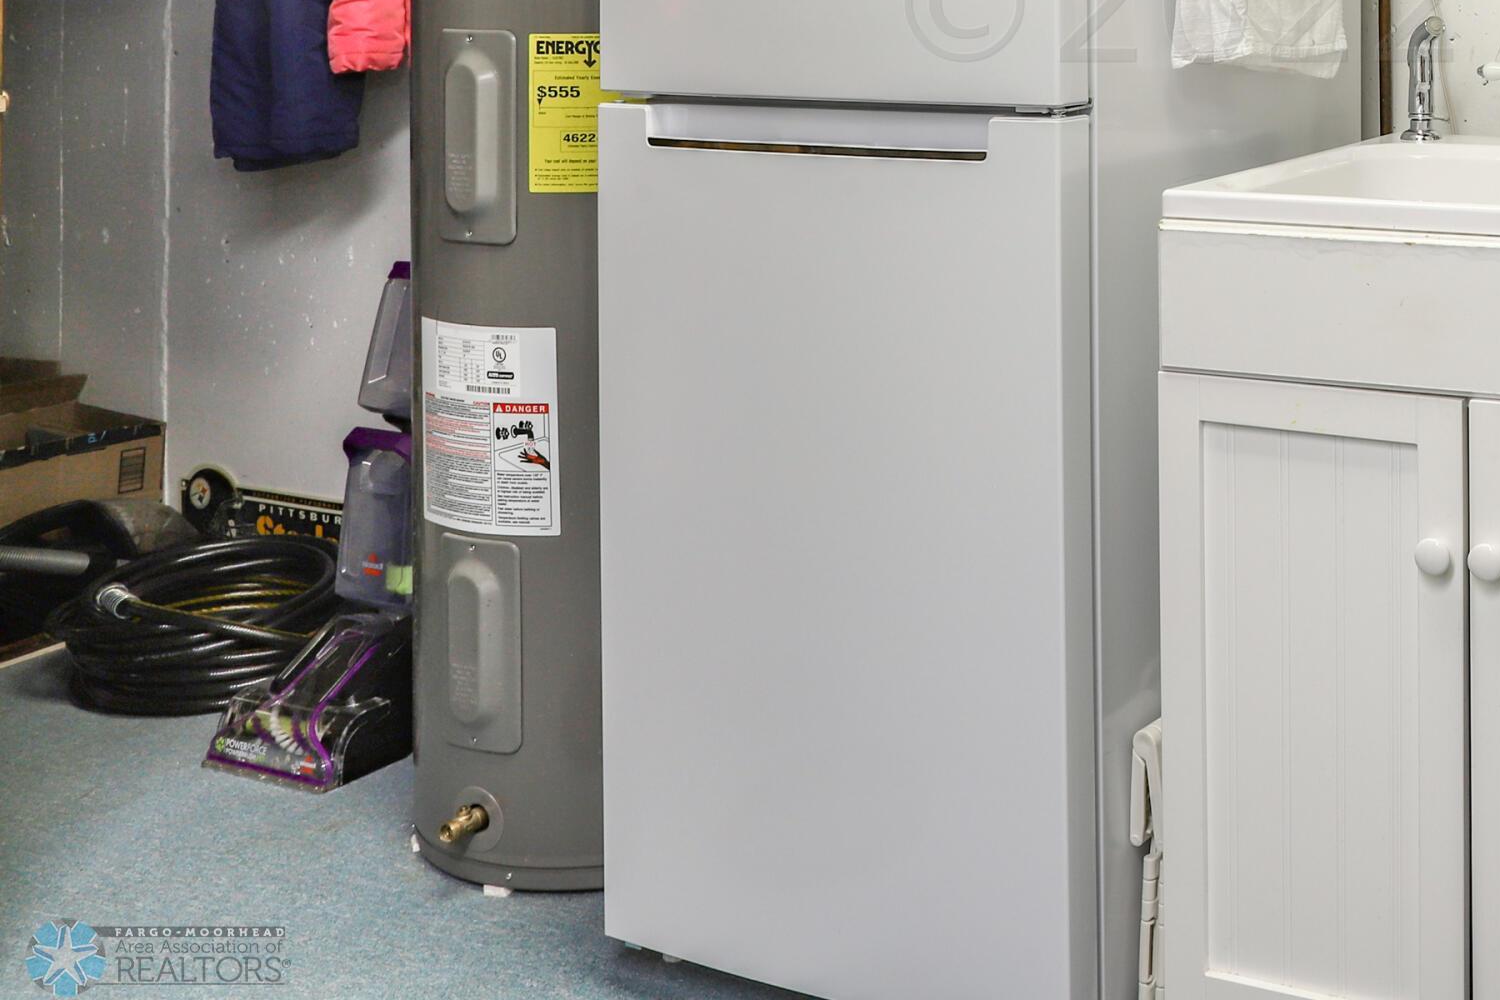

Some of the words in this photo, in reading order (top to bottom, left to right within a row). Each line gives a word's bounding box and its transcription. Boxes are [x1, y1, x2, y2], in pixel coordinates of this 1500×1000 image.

[536, 85, 581, 99] $555
[562, 133, 596, 143] 4622
[505, 404, 546, 413] DANGER
[258, 502, 343, 526] PITTSBUR
[225, 738, 268, 755] POWERFORCE
